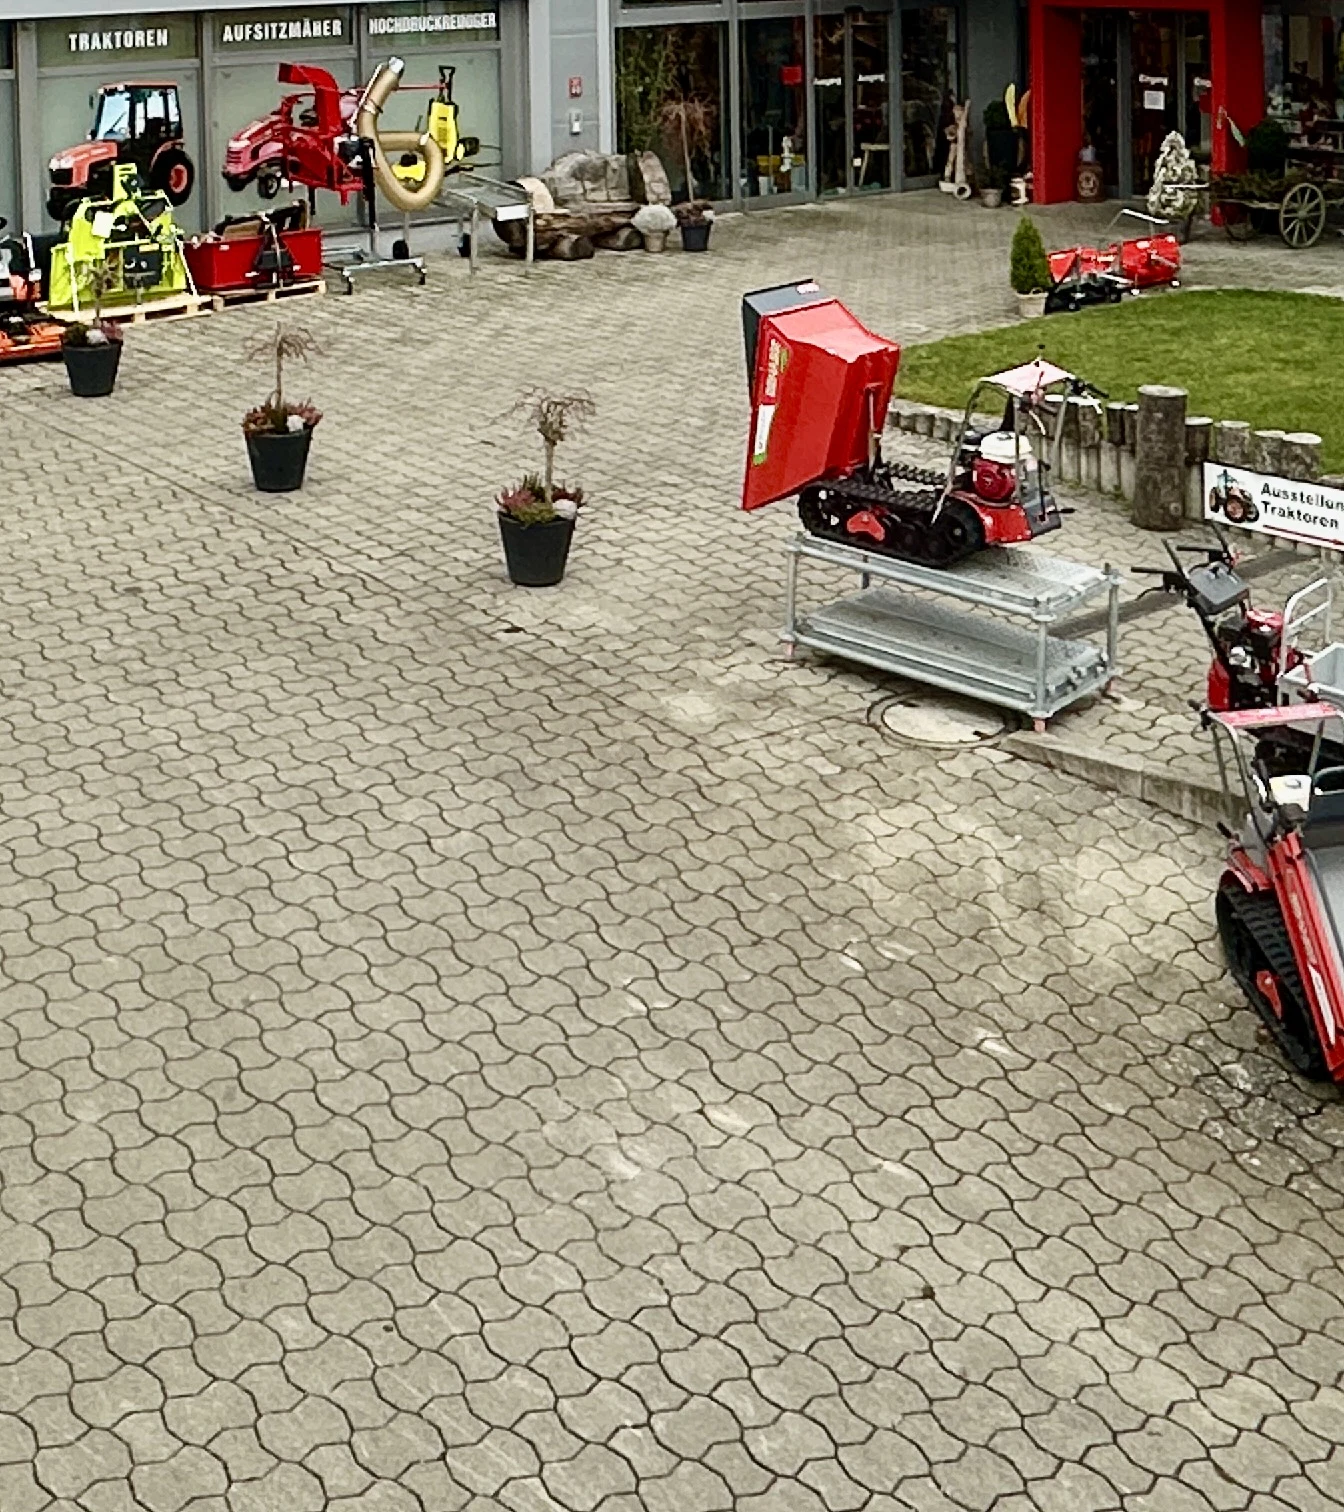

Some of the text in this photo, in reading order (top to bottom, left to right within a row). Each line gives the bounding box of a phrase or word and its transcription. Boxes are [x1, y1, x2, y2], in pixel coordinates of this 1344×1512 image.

[68, 28, 169, 52] TRAKTOREN
[222, 18, 343, 42] AUFSITZMÄHER
[1261, 500, 1339, 528] Traktoren
